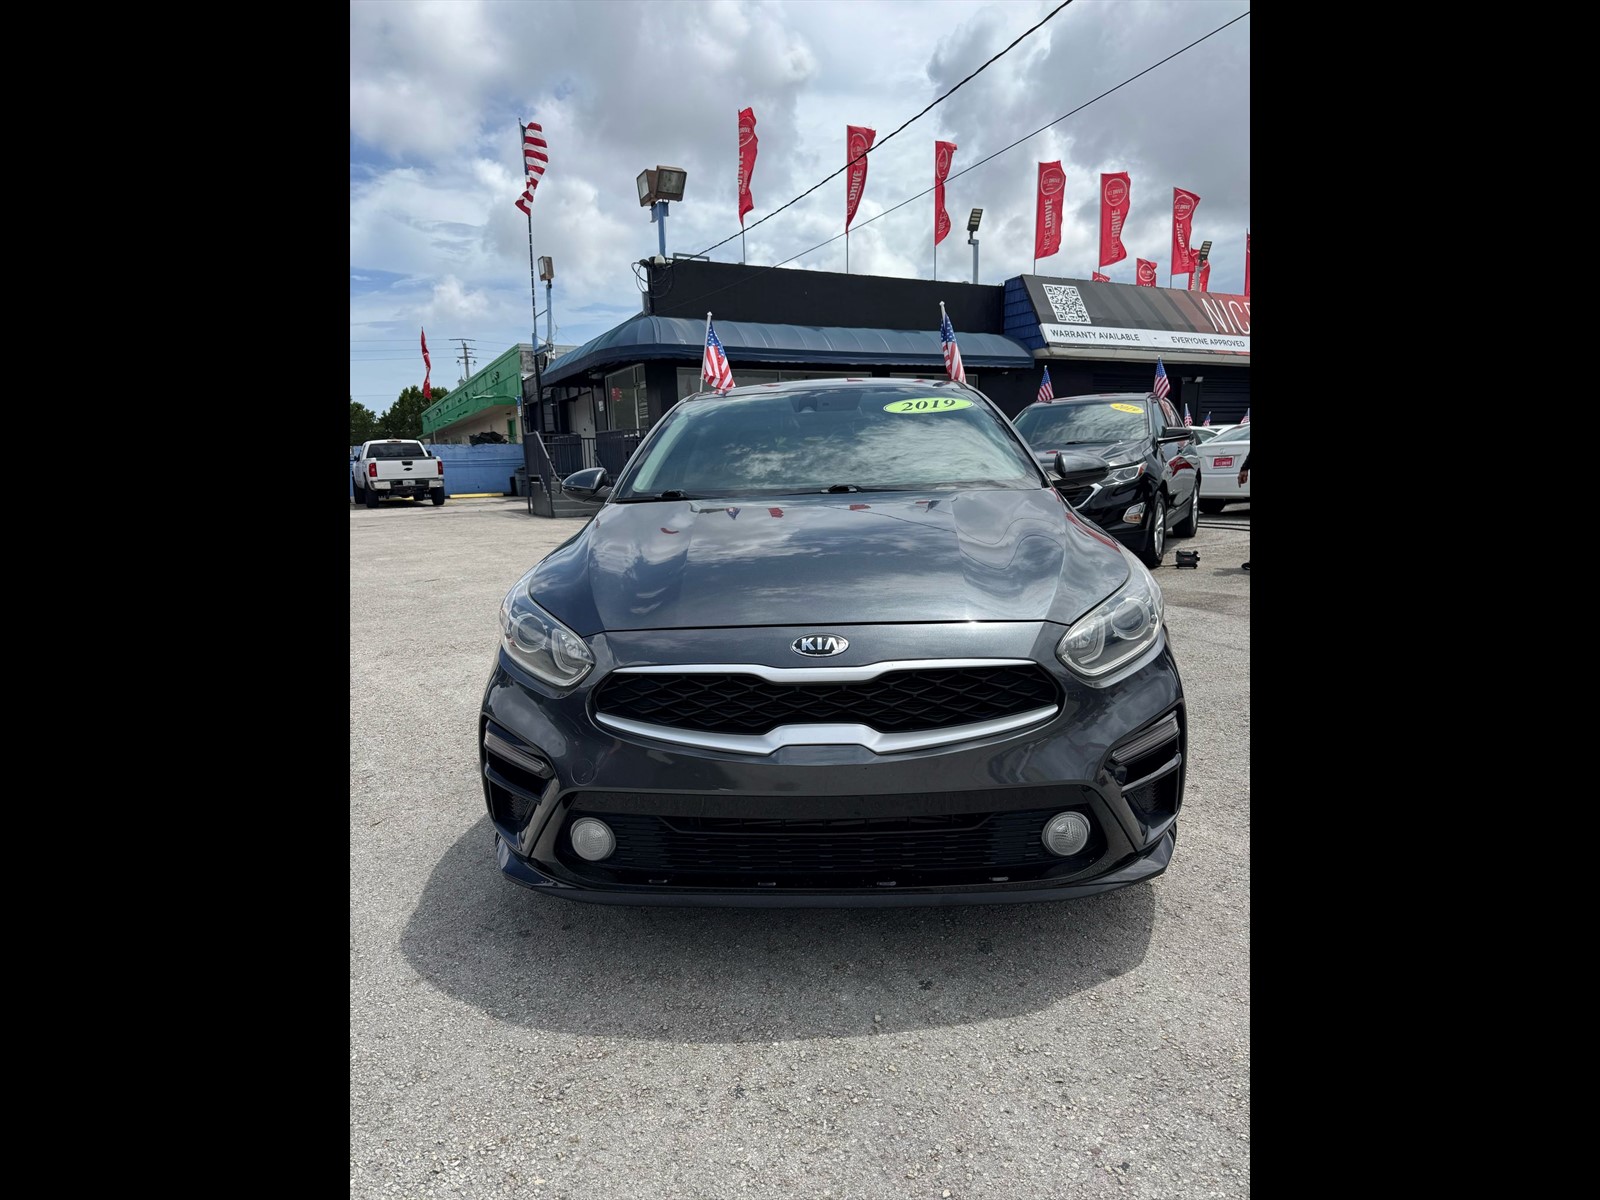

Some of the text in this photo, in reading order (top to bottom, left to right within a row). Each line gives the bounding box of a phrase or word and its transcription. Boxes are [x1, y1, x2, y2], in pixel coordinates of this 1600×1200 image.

[1044, 198, 1053, 229] DRIVE
[1050, 329, 1141, 342] WARRANTY AVAILABLE
[1171, 336, 1246, 348] EVERYONE APPROVED
[901, 399, 956, 412] 2019
[801, 637, 839, 651] KIA
